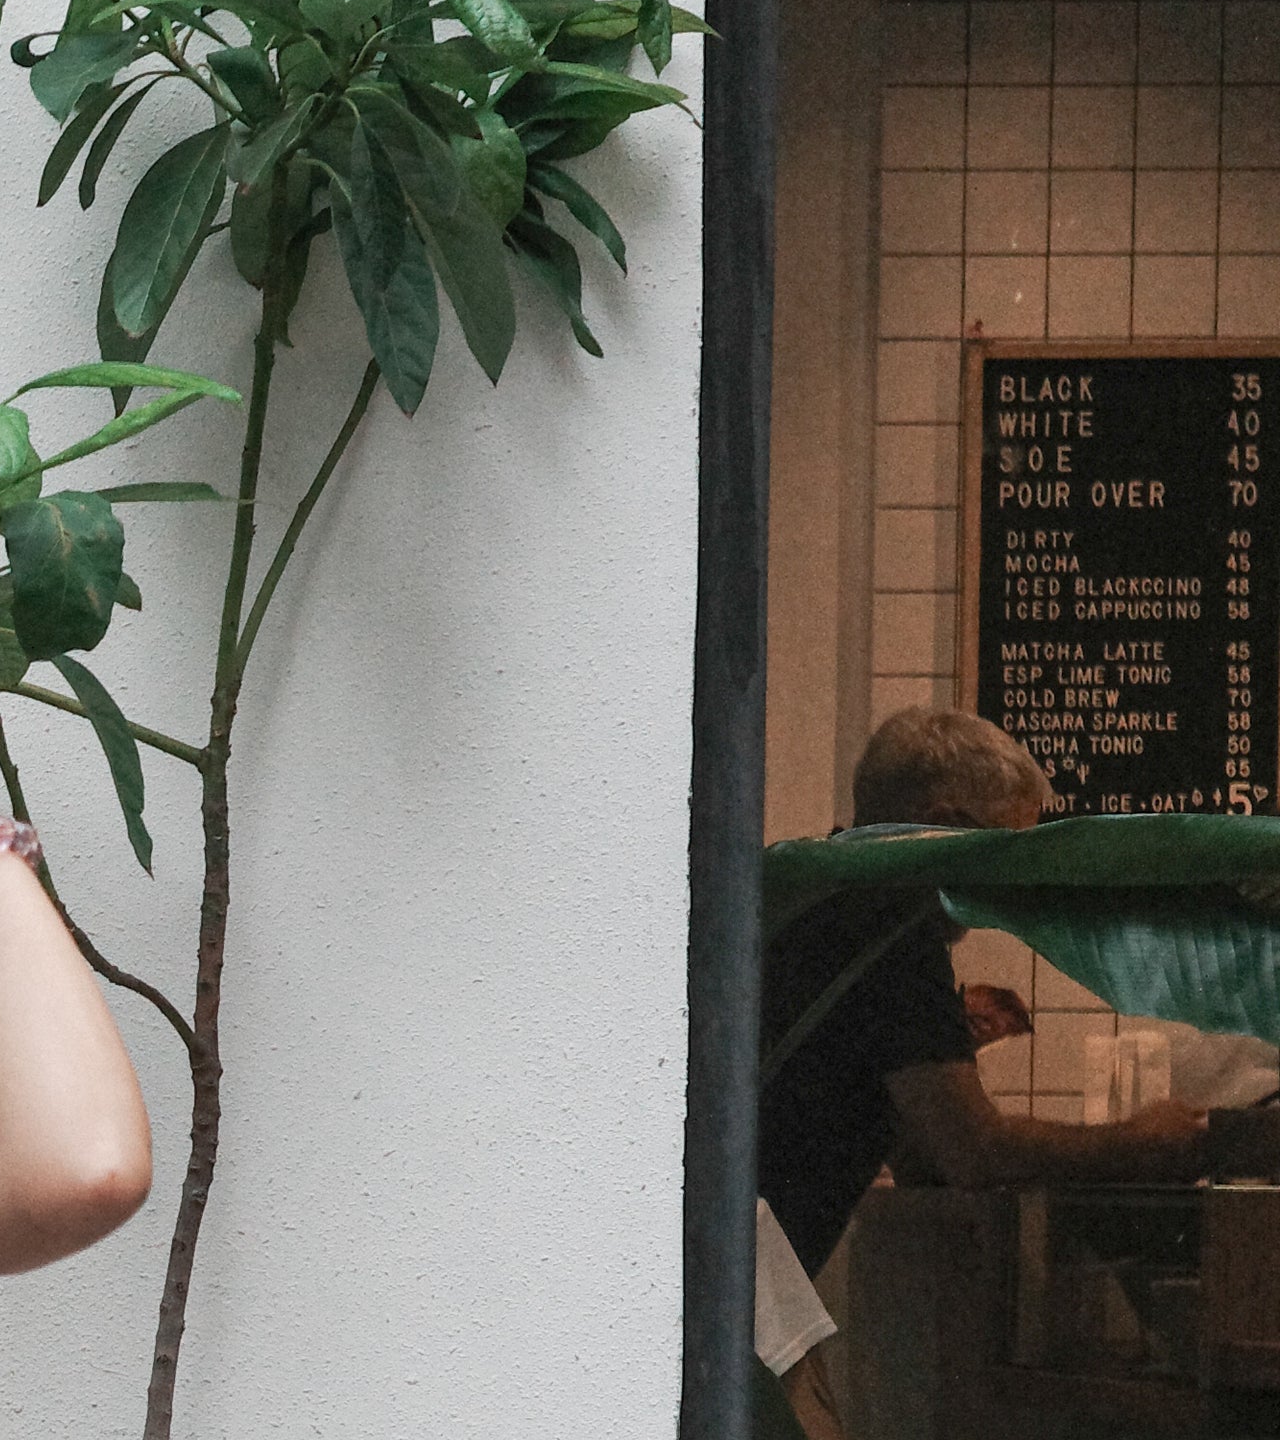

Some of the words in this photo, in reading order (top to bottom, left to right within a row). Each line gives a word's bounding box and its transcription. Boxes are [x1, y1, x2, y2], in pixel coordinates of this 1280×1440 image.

[1000, 375, 1093, 402] BLACK
[1232, 373, 1262, 401] 35
[999, 412, 1093, 437] WHITE
[1228, 410, 1260, 436] 40
[1228, 445, 1260, 471] 45
[999, 480, 1070, 508] POUR
[1092, 480, 1165, 508] OVER
[1229, 481, 1257, 507] 70
[1007, 531, 1074, 549] DIRTY
[1228, 530, 1251, 548] 40
[1005, 554, 1080, 573] MOCHA
[1005, 578, 1060, 596] ICED
[1005, 601, 1060, 620] ICED
[1075, 600, 1201, 620] CAPPUCCINO
[1001, 643, 1084, 661] MATCHA
[1104, 642, 1165, 661] LATTE
[1226, 642, 1250, 661] 45
[1004, 665, 1042, 684] ESP
[1058, 666, 1105, 684] LIME
[1119, 666, 1172, 684] TONIC
[1004, 689, 1055, 708] COLD
[1064, 689, 1120, 708] BREW
[1227, 688, 1251, 708] 70
[1003, 712, 1084, 731] CASCARA
[1093, 712, 1178, 731] SPARKLE
[1089, 735, 1144, 755] TONIC
[1100, 794, 1133, 812] ICE
[1152, 793, 1188, 813] OAT
